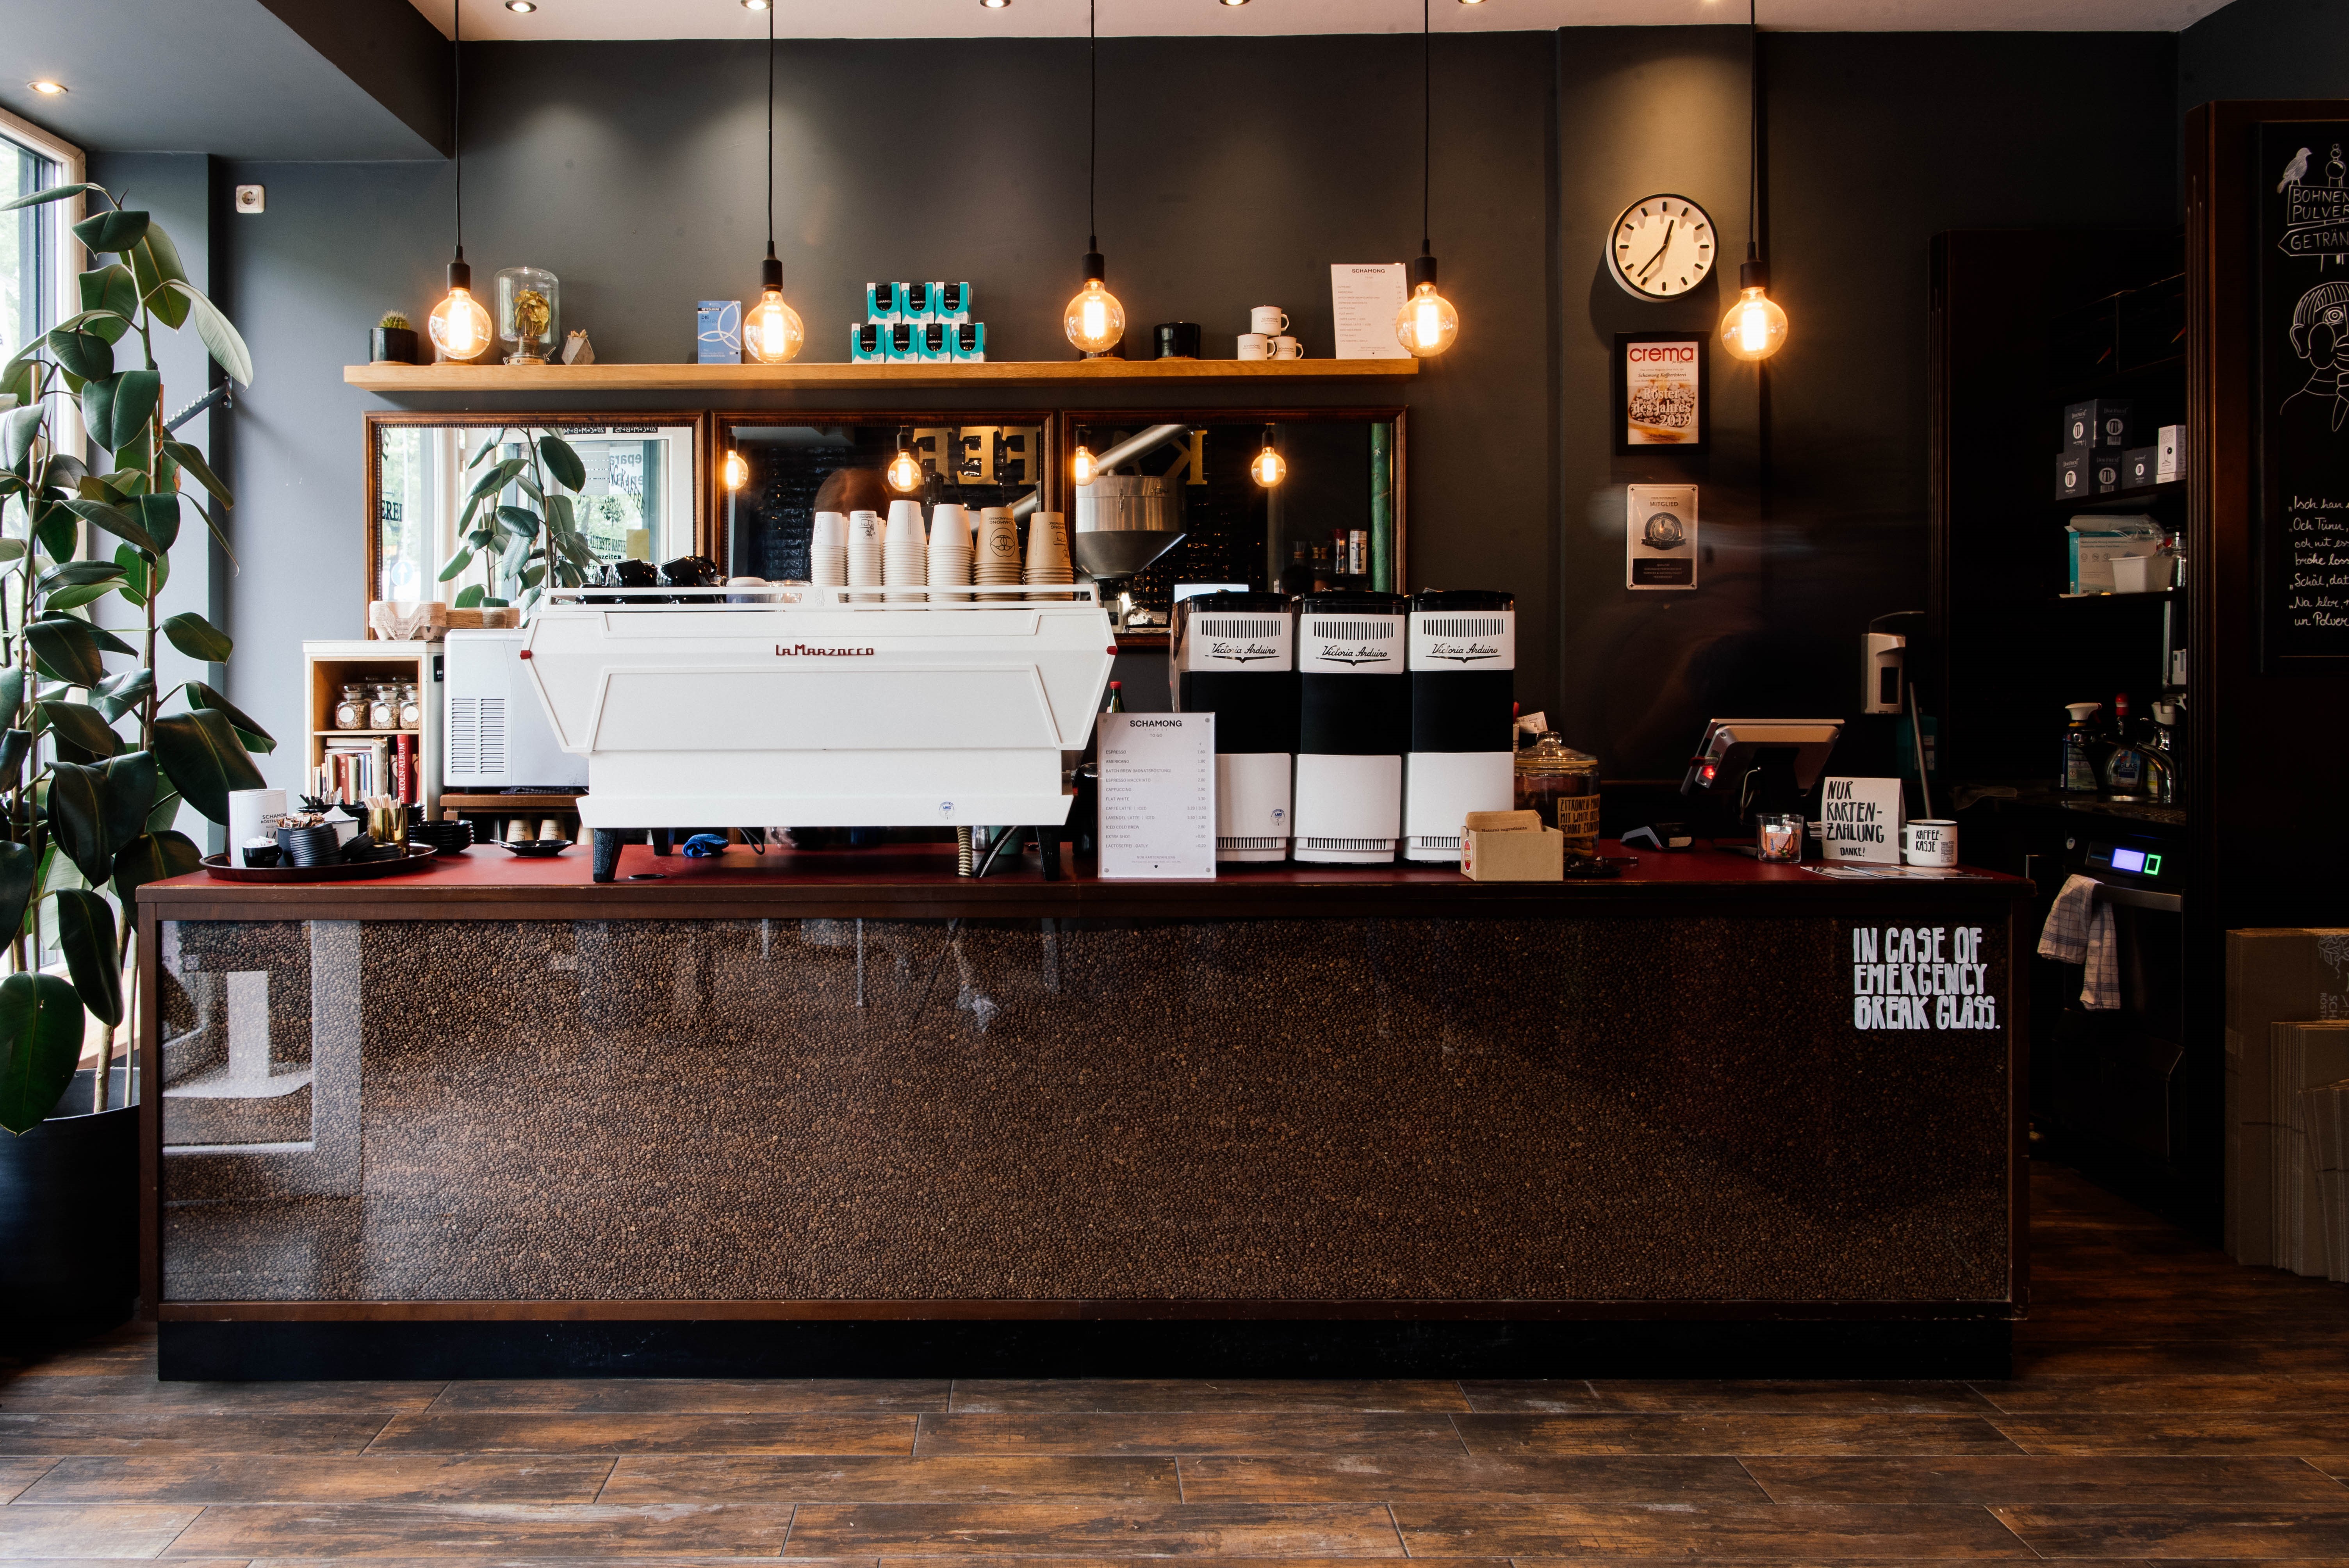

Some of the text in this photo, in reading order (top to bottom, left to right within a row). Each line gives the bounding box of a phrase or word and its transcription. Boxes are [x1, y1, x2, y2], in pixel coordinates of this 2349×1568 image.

[1629, 347, 1693, 362] crema
[1633, 400, 1691, 415] des Jahres
[1659, 415, 1692, 426] 2019
[1212, 643, 1276, 654] Victoria Arduino
[1322, 645, 1387, 657] Victoria Arduino
[1432, 643, 1498, 655] Victoria Arduino
[1827, 781, 1853, 800] NUR
[1560, 813, 1570, 824] MIT
[1573, 812, 1588, 823] WHITE
[1826, 802, 1882, 823] KARTEN-
[1826, 823, 1884, 843] ZAHLUNG
[1916, 830, 1943, 841] KAFFEE-
[1840, 847, 1865, 857] DANKE!
[1916, 841, 1936, 852] KASSE
[1854, 927, 1982, 964] IN CASE OF
[1854, 964, 1987, 996] EMERGENCY
[1854, 995, 2001, 1030] BREAK GLASS.
